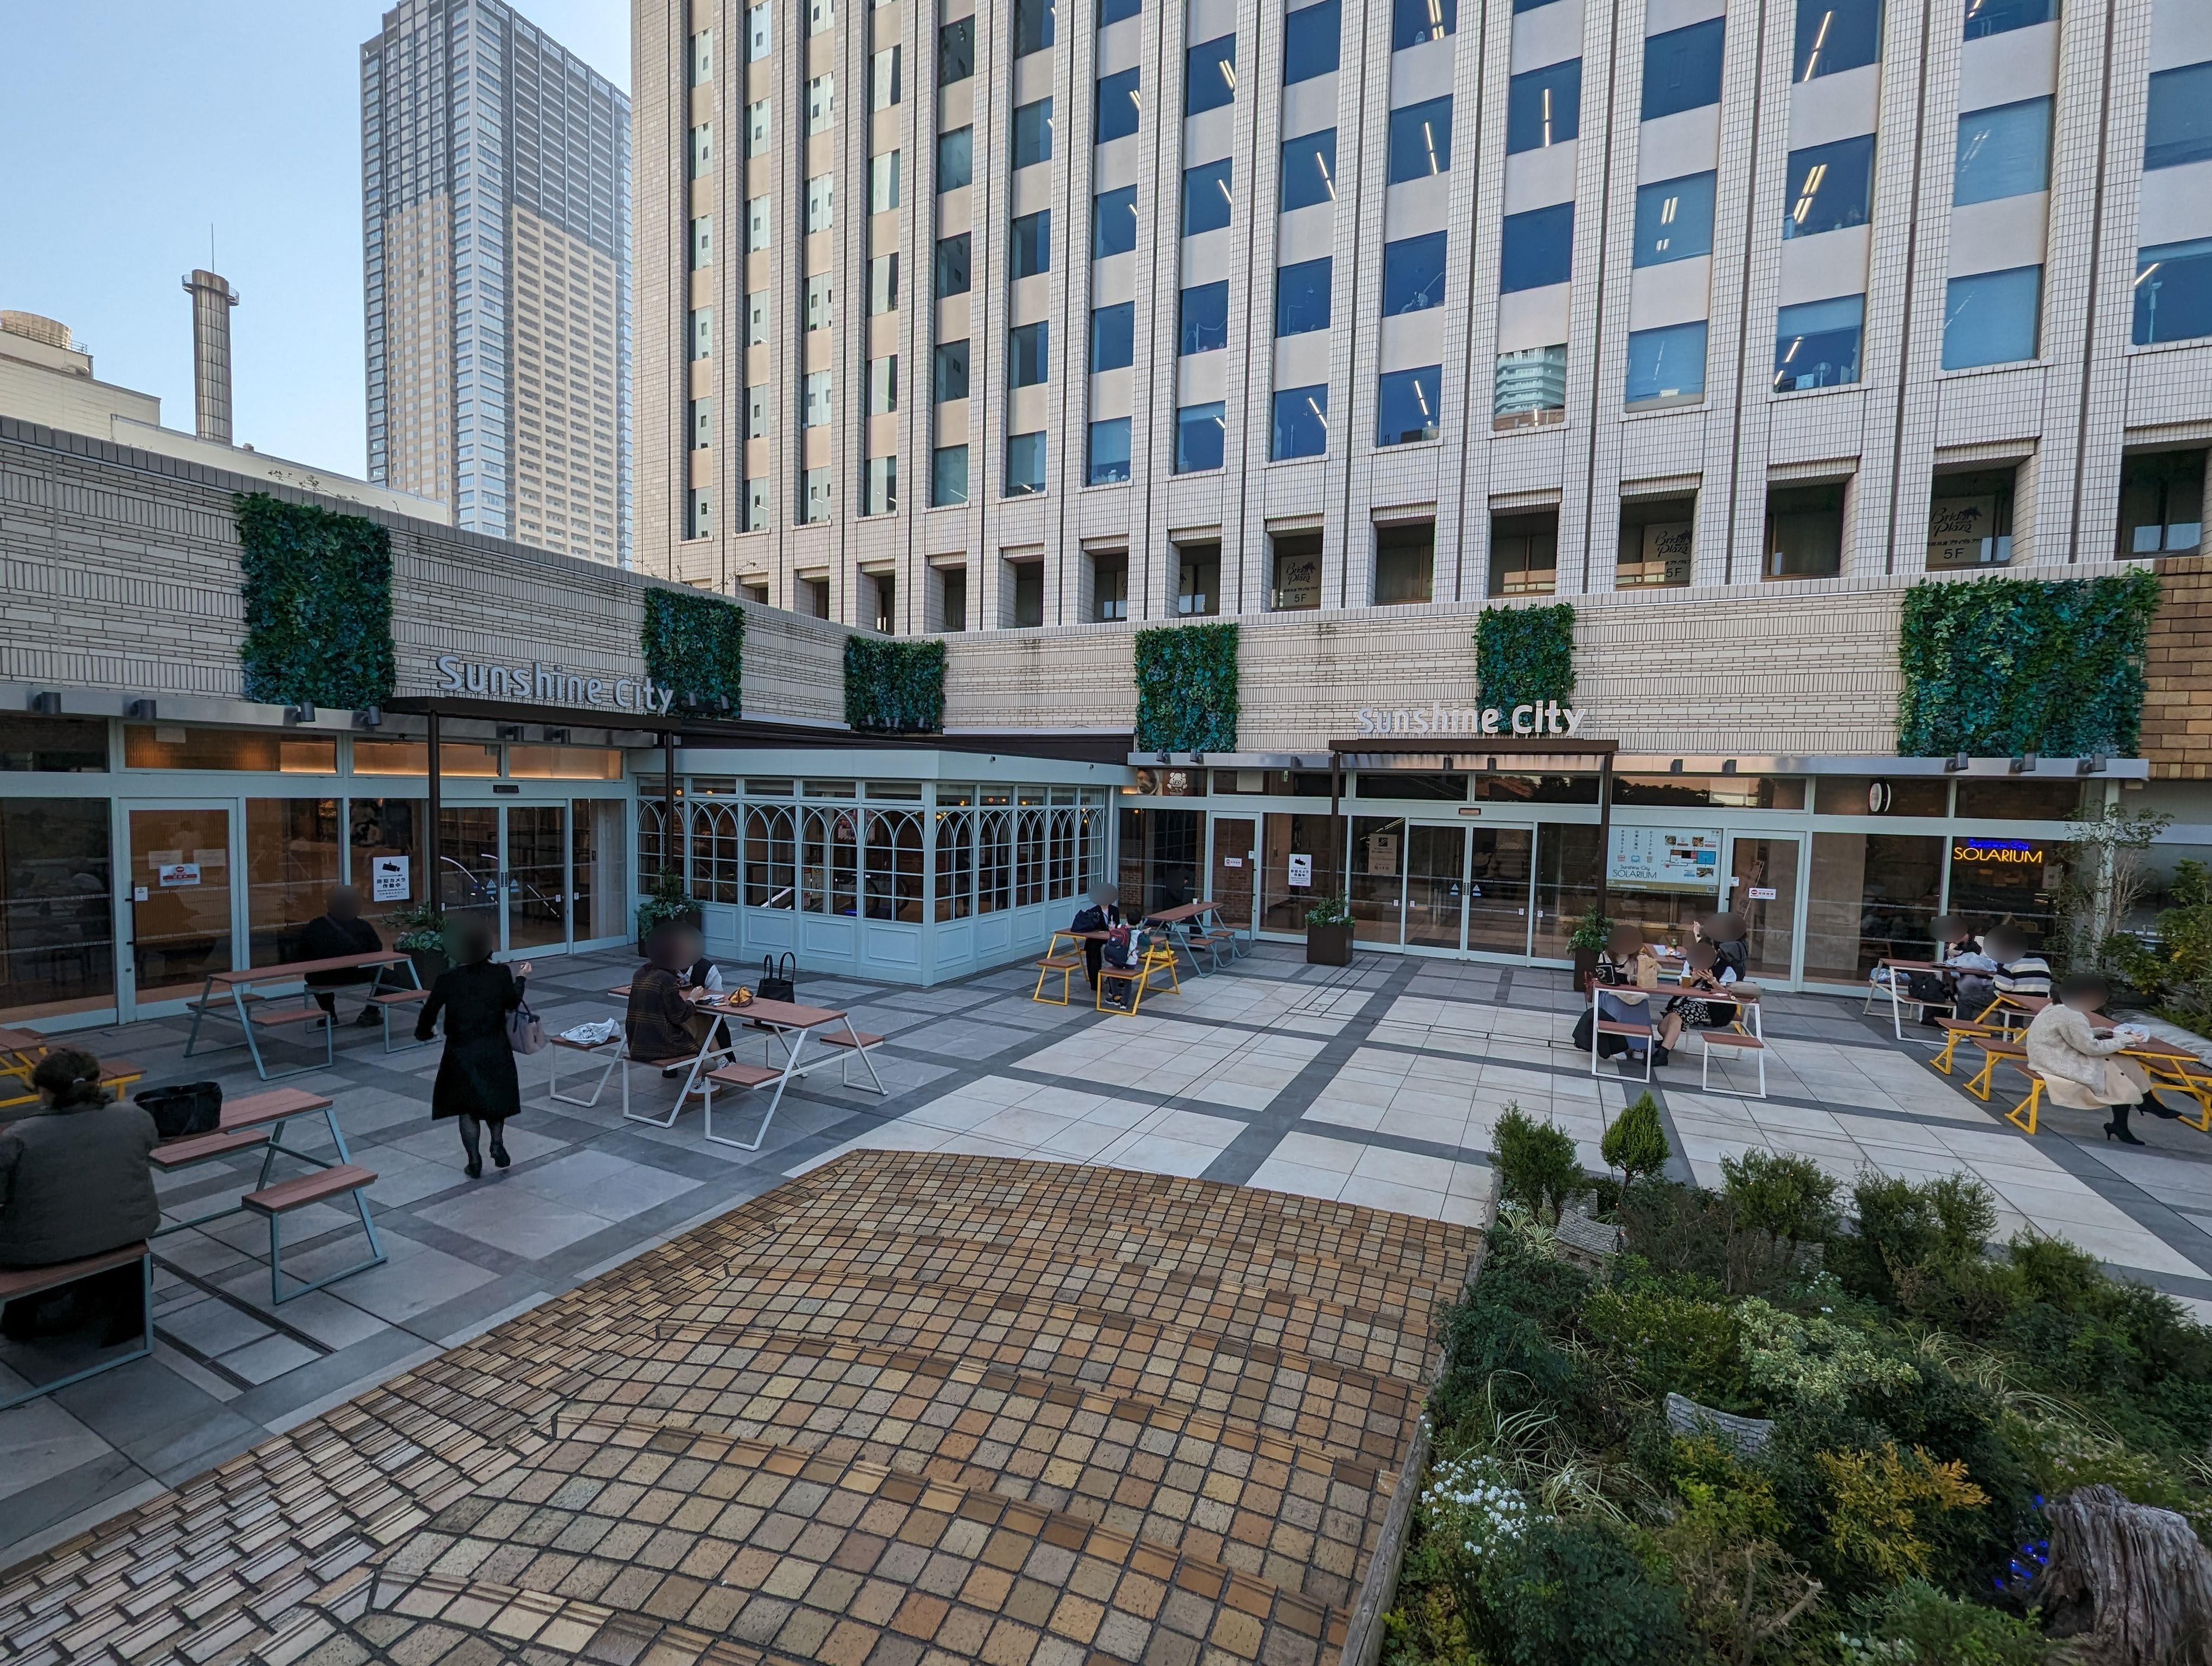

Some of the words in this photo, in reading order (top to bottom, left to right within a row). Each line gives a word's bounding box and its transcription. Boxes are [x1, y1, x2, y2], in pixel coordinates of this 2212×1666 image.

[1933, 522, 1972, 537] Plaza
[1657, 544, 1688, 558] Plaza
[1944, 548, 1965, 559] 5F
[1666, 568, 1682, 577] 5F
[1288, 574, 1310, 585] Plaza
[1294, 594, 1307, 603] 5F
[436, 654, 603, 705] Sunshine
[613, 675, 676, 717] City
[1357, 702, 1499, 733] Sunshine
[1512, 700, 1588, 737] City
[1953, 847, 2043, 863] SOLARIUM
[1613, 869, 1657, 879] SOLARIUM
